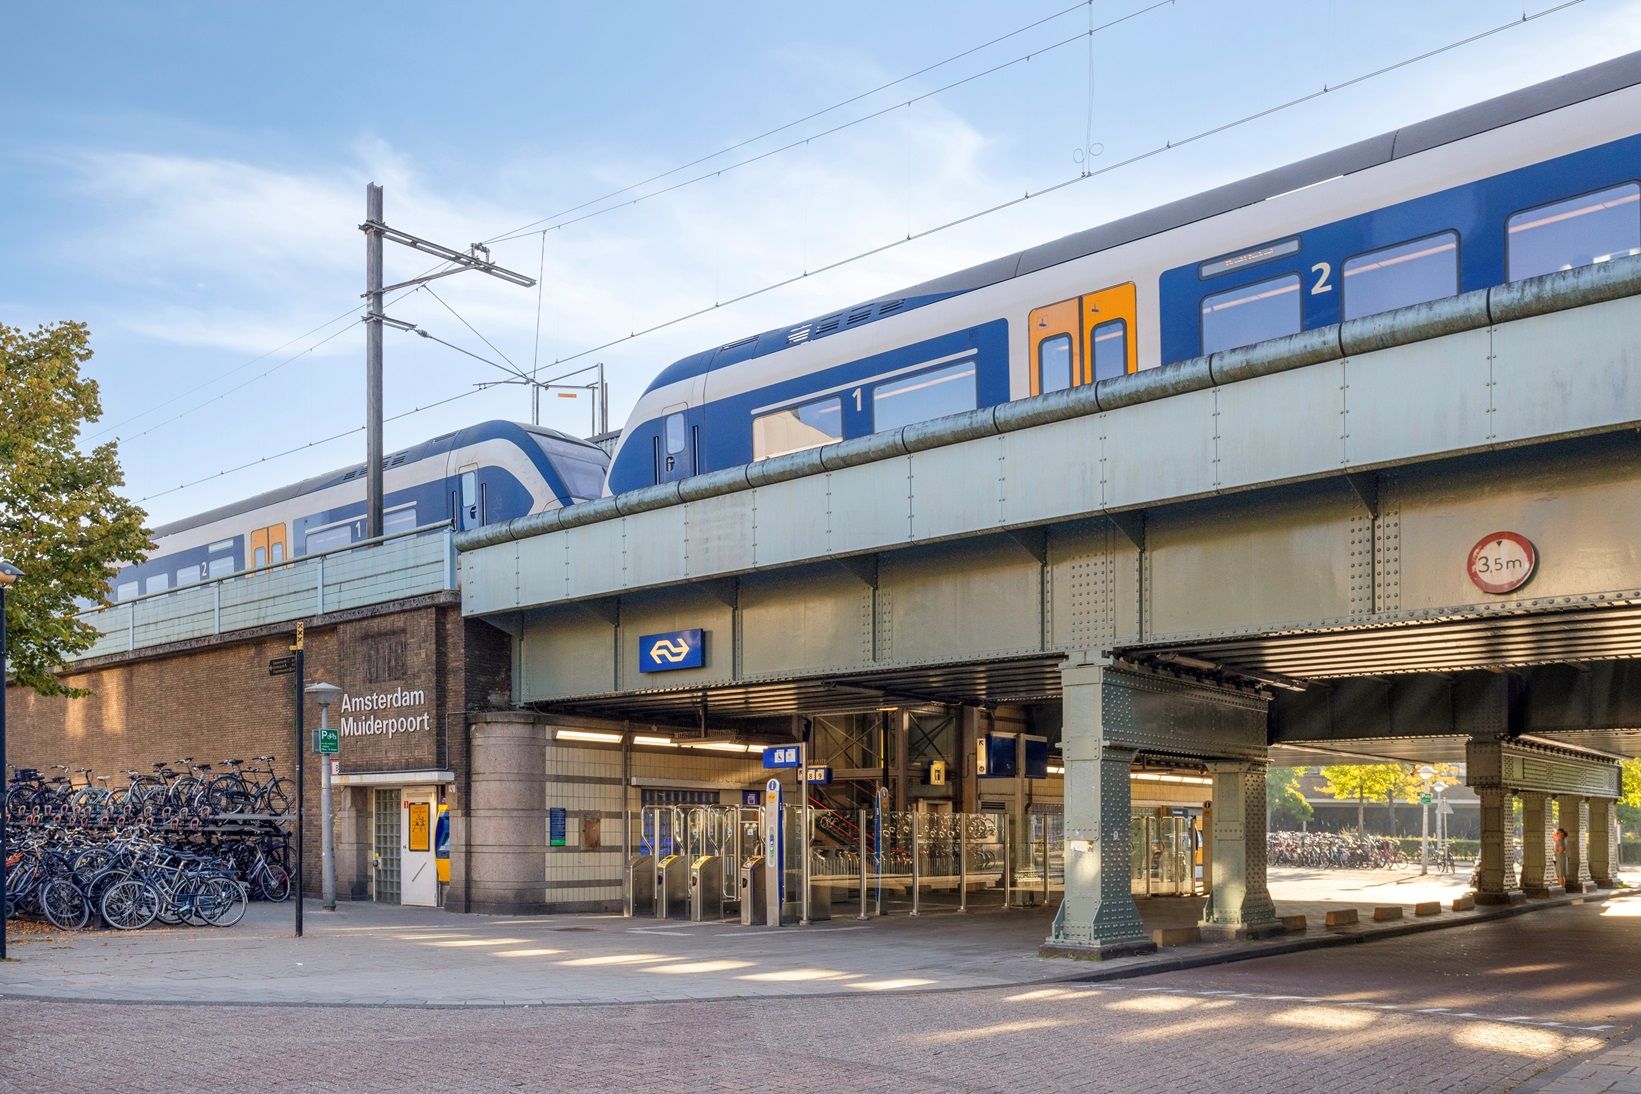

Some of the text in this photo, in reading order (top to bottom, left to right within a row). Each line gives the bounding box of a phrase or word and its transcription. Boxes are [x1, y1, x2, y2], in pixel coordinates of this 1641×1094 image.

[1311, 262, 1332, 295] 2
[852, 388, 862, 411] 1
[355, 521, 361, 538] 1
[201, 561, 207, 576] 2
[341, 687, 424, 713] Amsterdam
[321, 730, 328, 740] P
[341, 712, 430, 739] Muiderpoort
